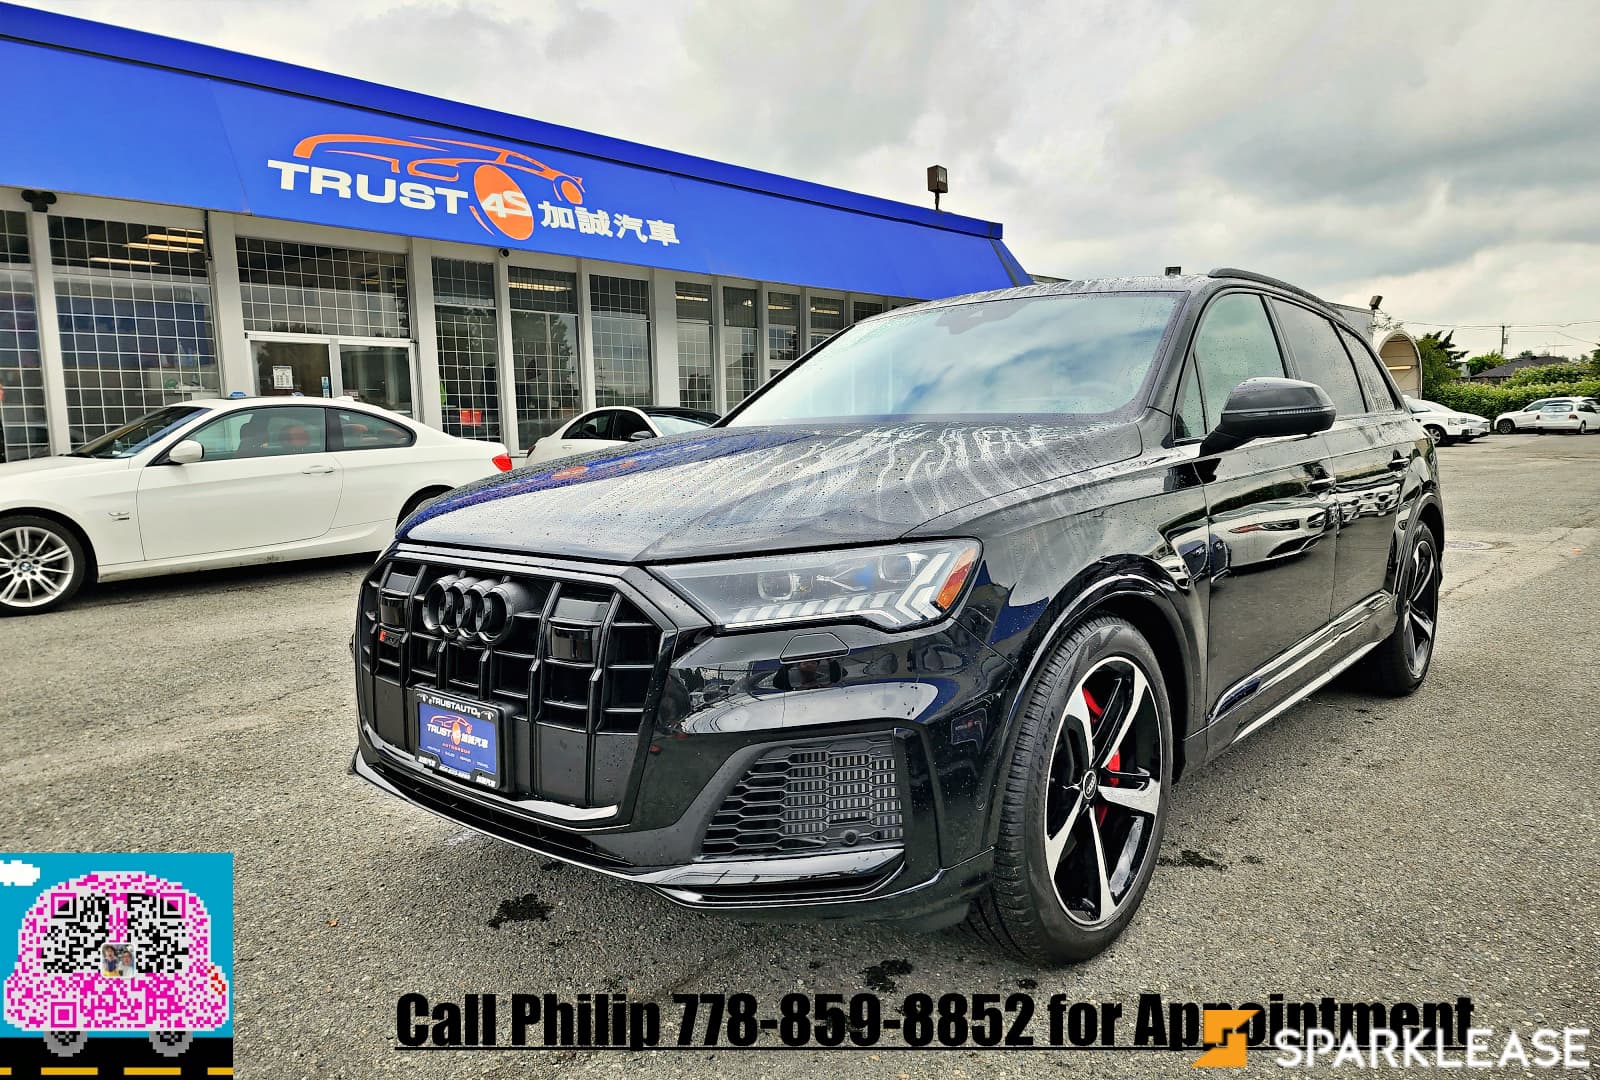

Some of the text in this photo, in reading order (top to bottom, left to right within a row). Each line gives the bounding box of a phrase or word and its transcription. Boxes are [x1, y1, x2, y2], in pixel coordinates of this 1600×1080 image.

[267, 159, 469, 215] TRUST
[481, 190, 533, 219] 4S
[537, 200, 681, 247] 加誠汽車
[427, 724, 452, 738] TRUST
